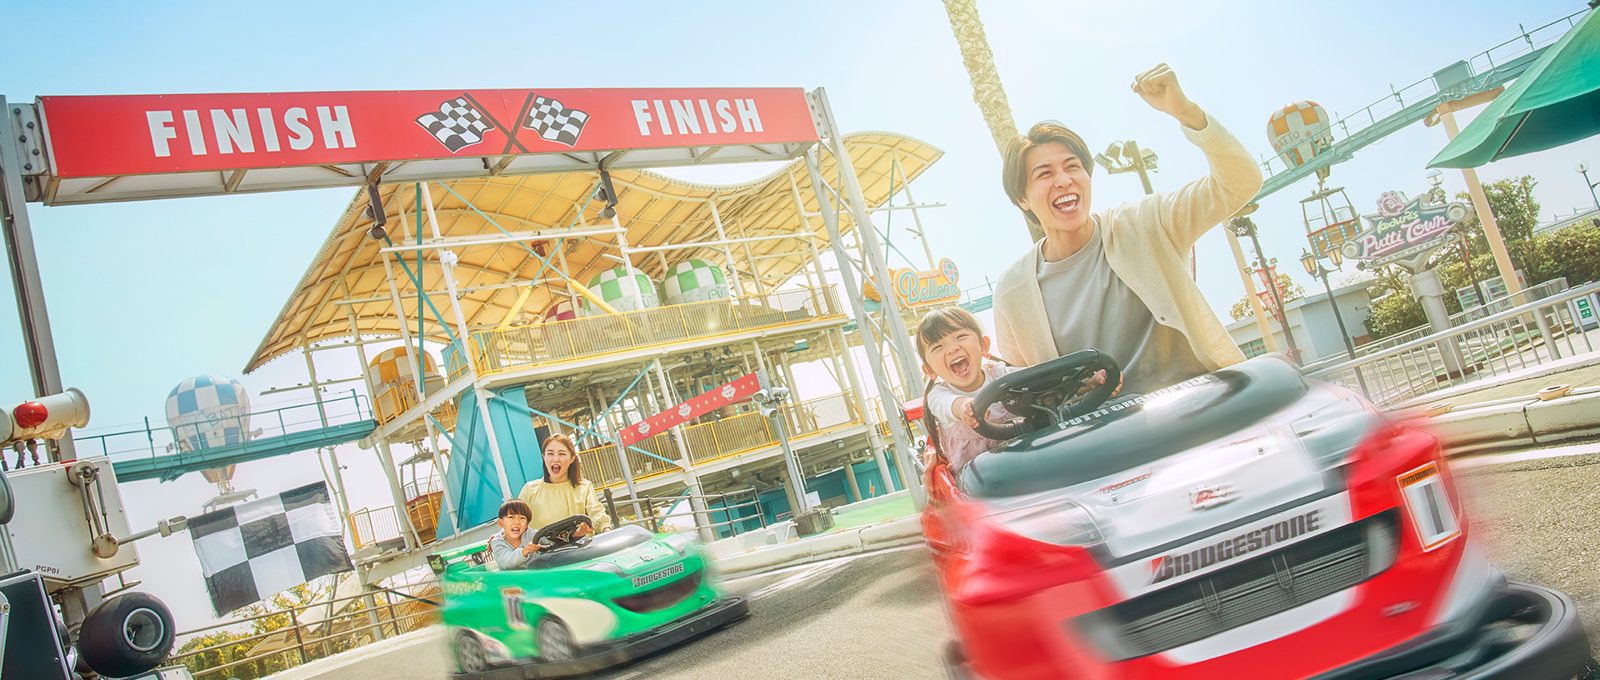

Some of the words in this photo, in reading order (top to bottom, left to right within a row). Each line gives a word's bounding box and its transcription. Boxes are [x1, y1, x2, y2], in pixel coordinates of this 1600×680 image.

[145, 105, 357, 158] FINISH
[631, 98, 764, 136] FINISH
[1359, 230, 1405, 259] Putti
[1401, 215, 1451, 242] Town
[899, 271, 960, 303] Balloon
[1058, 408, 1109, 430] PUTTI
[1150, 508, 1321, 584] BRIDGESTONE
[632, 563, 684, 588] BRIDGESTONE
